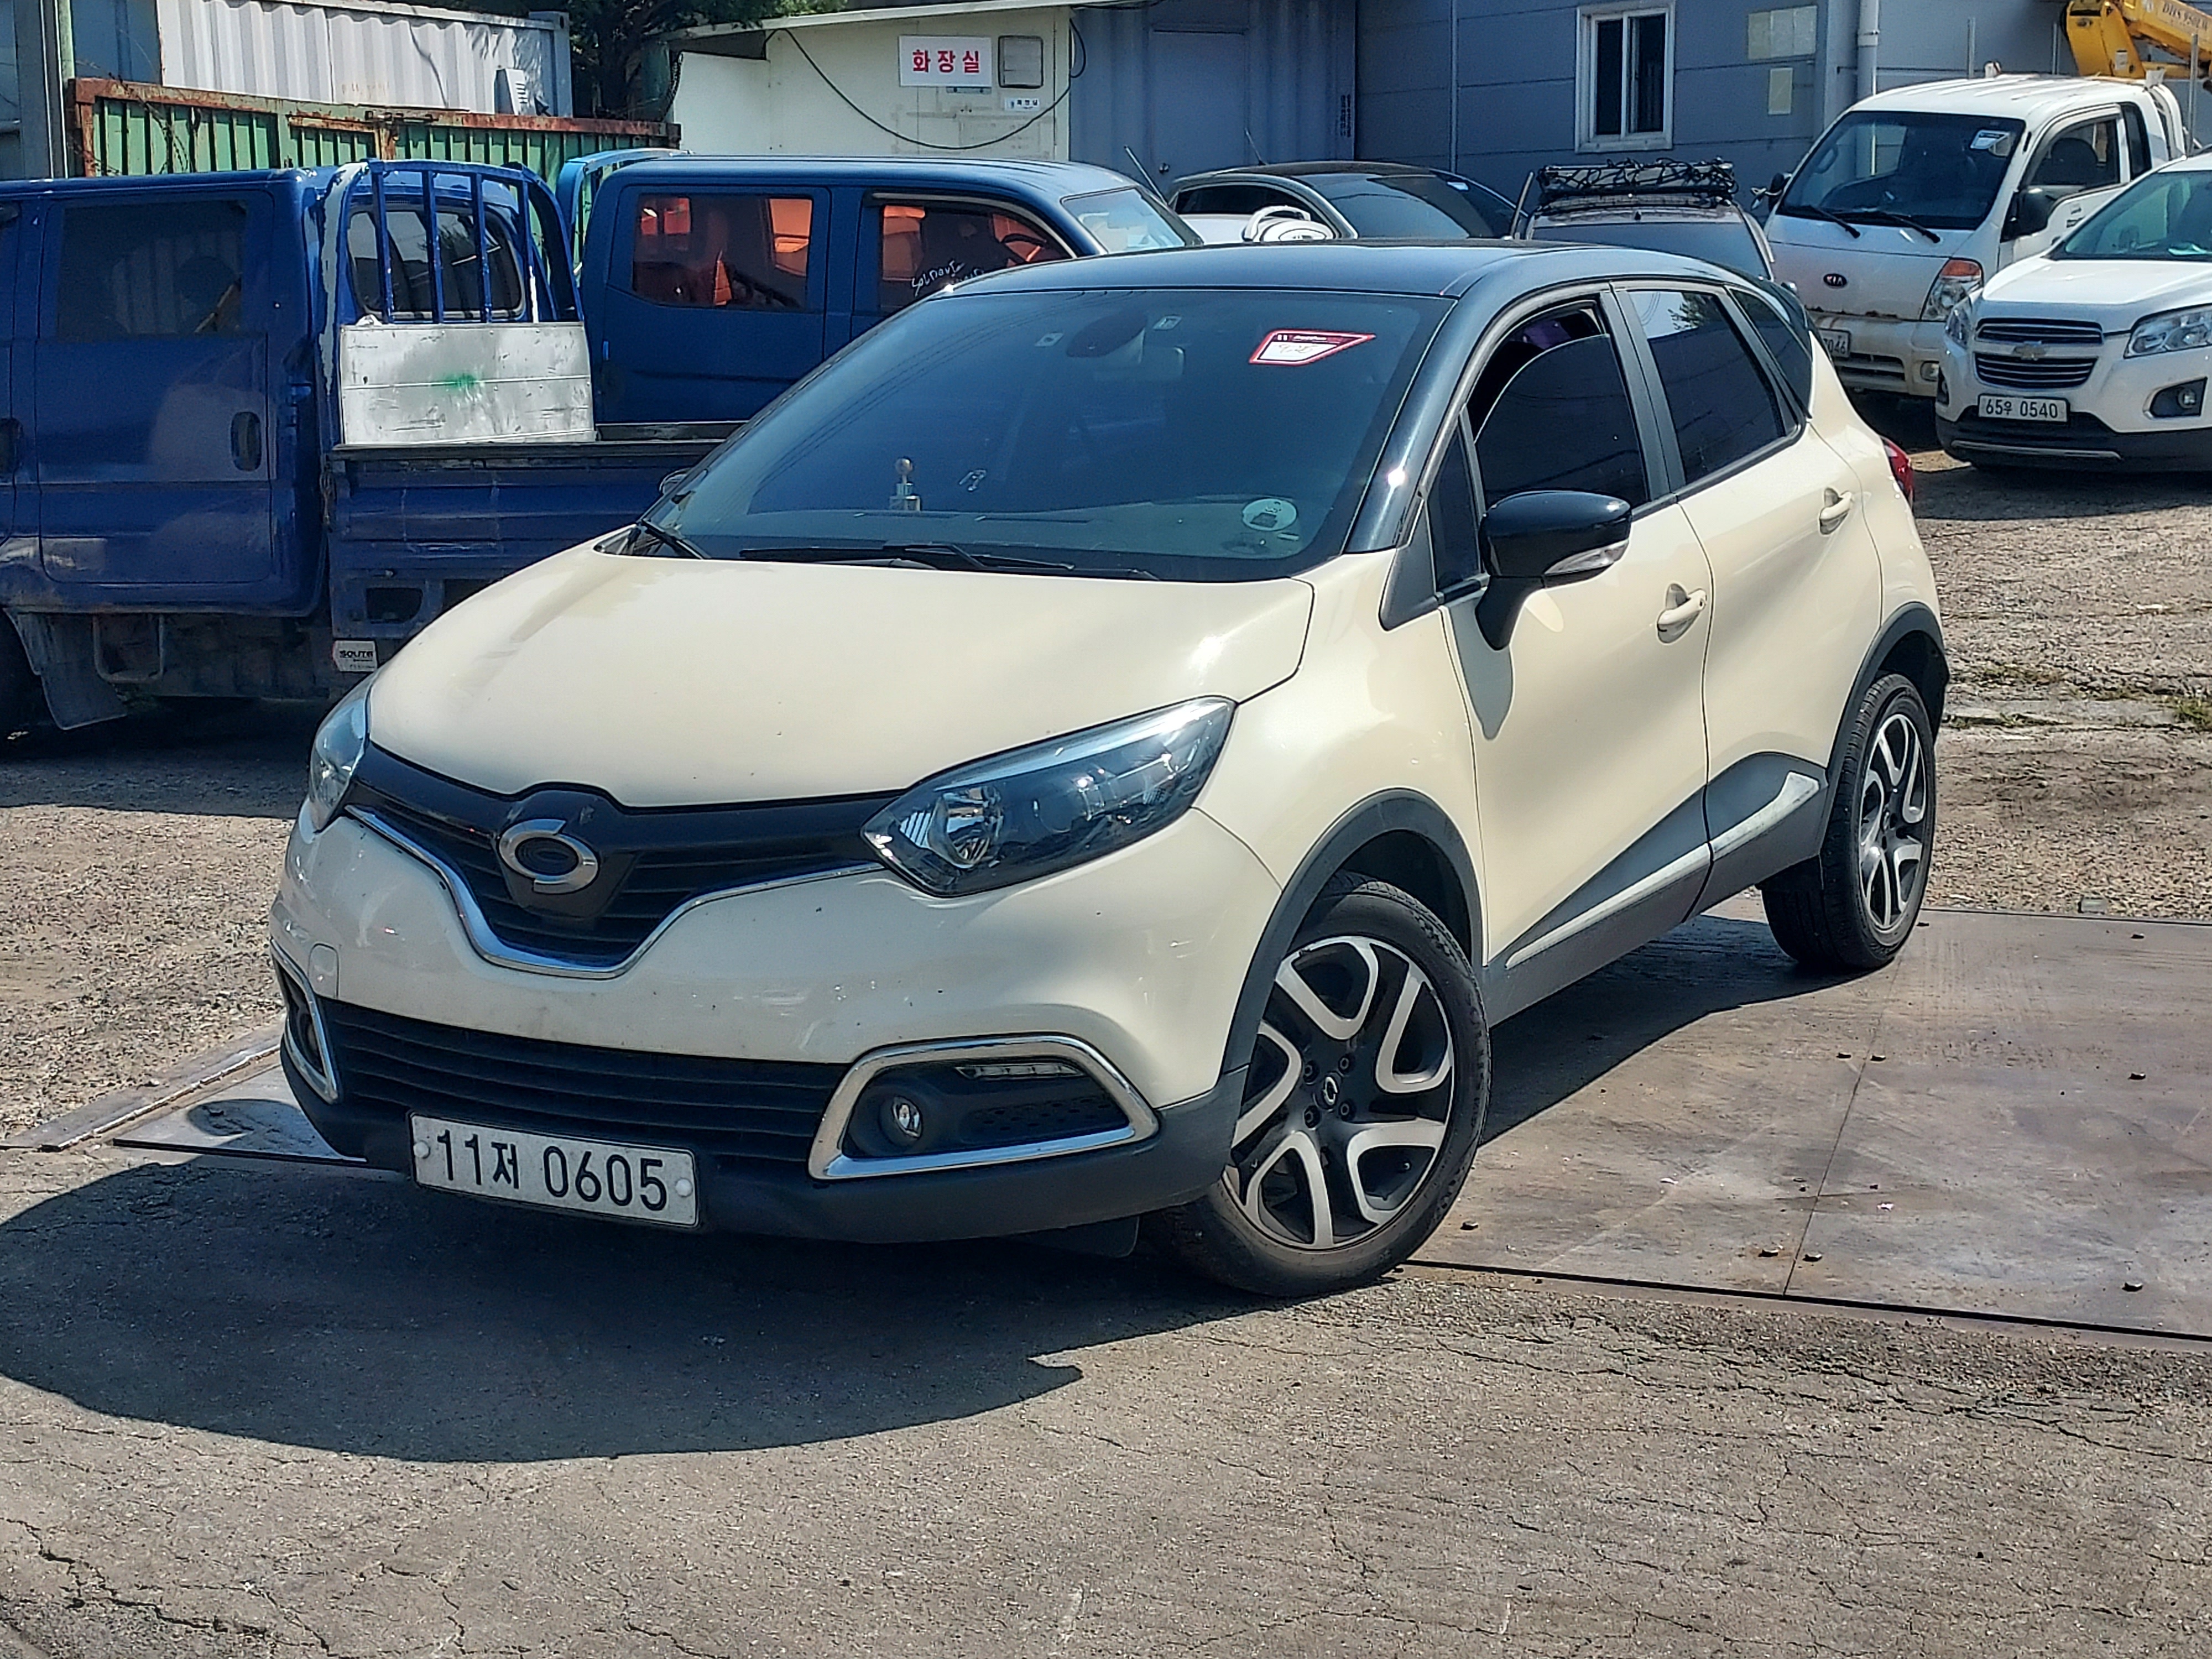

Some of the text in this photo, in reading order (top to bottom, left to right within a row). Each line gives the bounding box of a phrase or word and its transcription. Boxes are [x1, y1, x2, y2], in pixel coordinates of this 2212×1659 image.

[912, 49, 980, 74] 화장실
[1827, 276, 1843, 285] KIA
[1986, 399, 2058, 418] 65우 0540
[437, 1129, 667, 1211] 11저 0605
